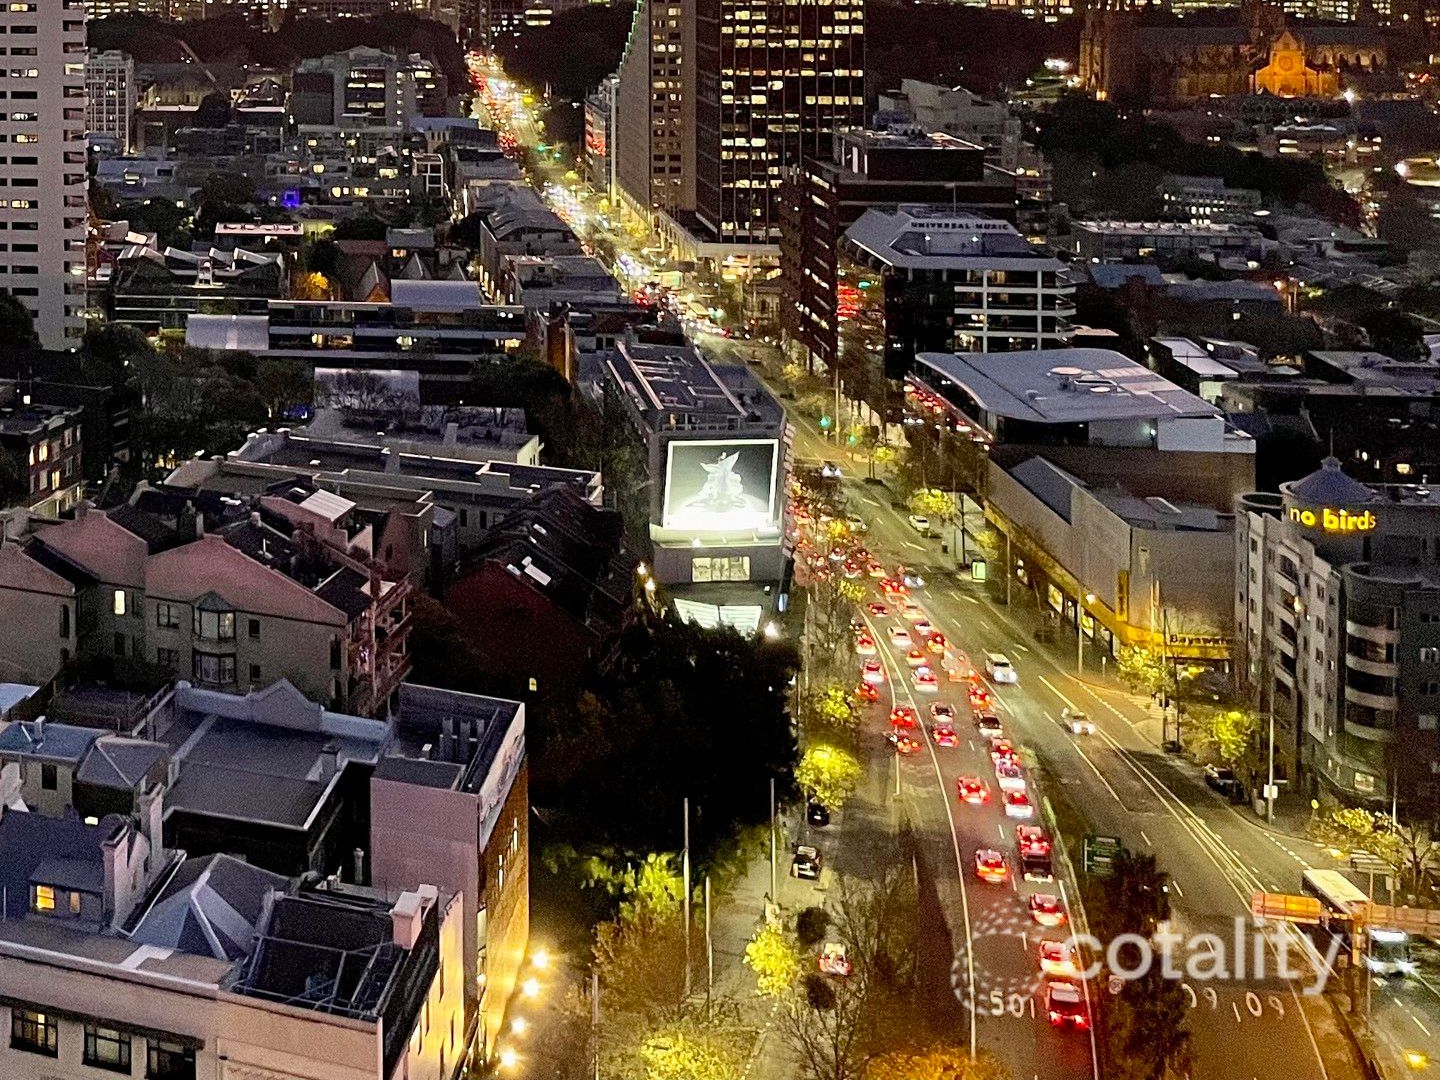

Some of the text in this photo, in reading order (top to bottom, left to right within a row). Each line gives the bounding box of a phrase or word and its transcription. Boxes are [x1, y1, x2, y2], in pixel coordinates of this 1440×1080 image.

[911, 222, 970, 230] UNIVERSAL
[1290, 507, 1376, 530] no birds
